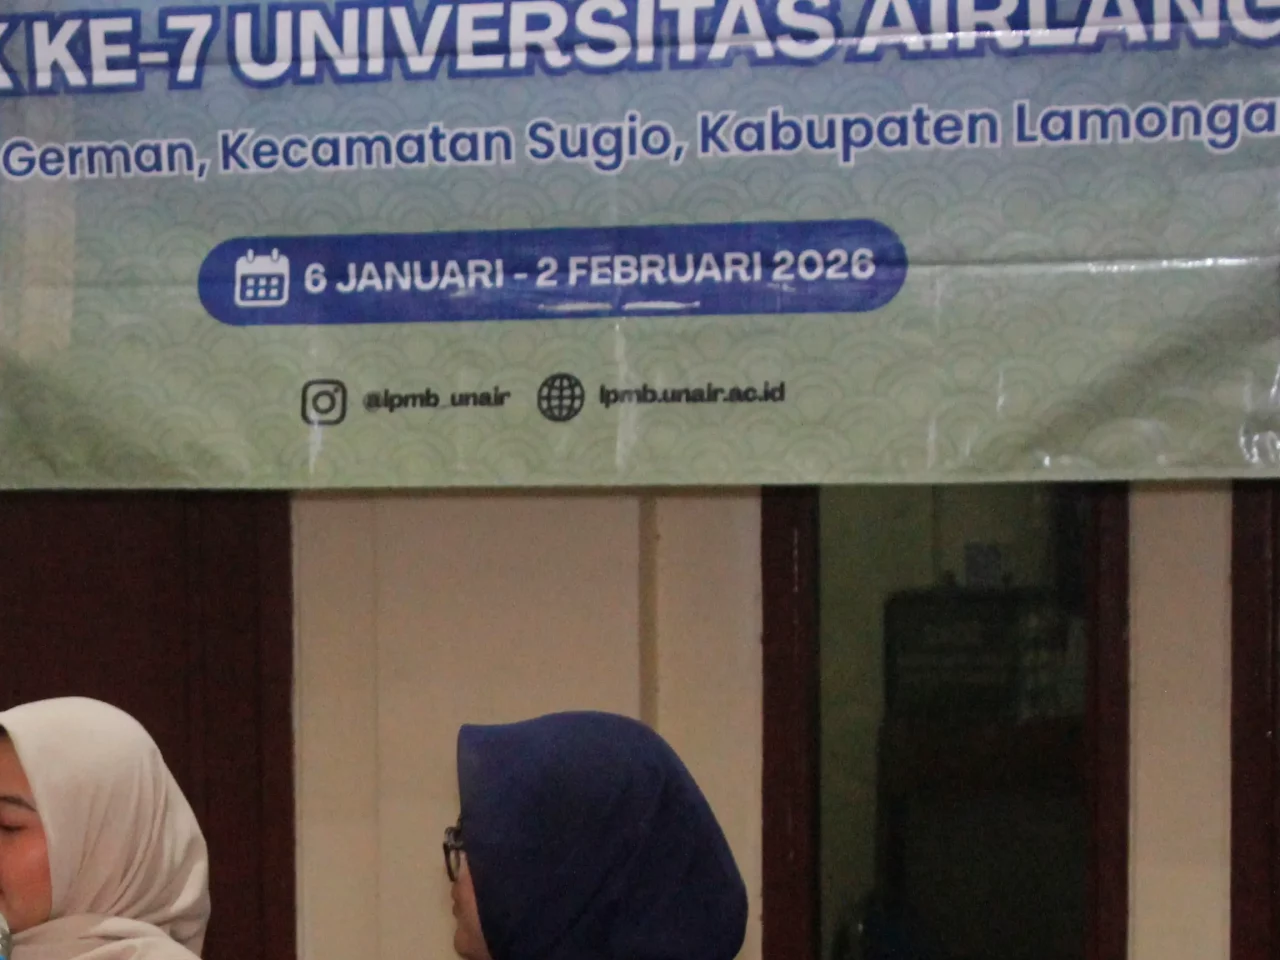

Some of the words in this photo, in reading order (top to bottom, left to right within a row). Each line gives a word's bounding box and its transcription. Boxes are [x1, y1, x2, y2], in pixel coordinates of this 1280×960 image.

[32, 14, 212, 87] KE-7
[233, 0, 835, 81] UNIVERSITAS
[1, 140, 207, 178] German,
[220, 125, 513, 170] Kecamatan
[527, 114, 683, 172] Sugio,
[701, 107, 998, 163] Kabupaten
[1016, 102, 1277, 150] Lamonga
[305, 263, 327, 292] 6
[336, 260, 504, 293] JANUARI
[536, 257, 558, 288] 2
[568, 250, 762, 286] FEBRUARI
[771, 248, 876, 282] 2026
[599, 380, 785, 409] lpmb.unair.ac.id
